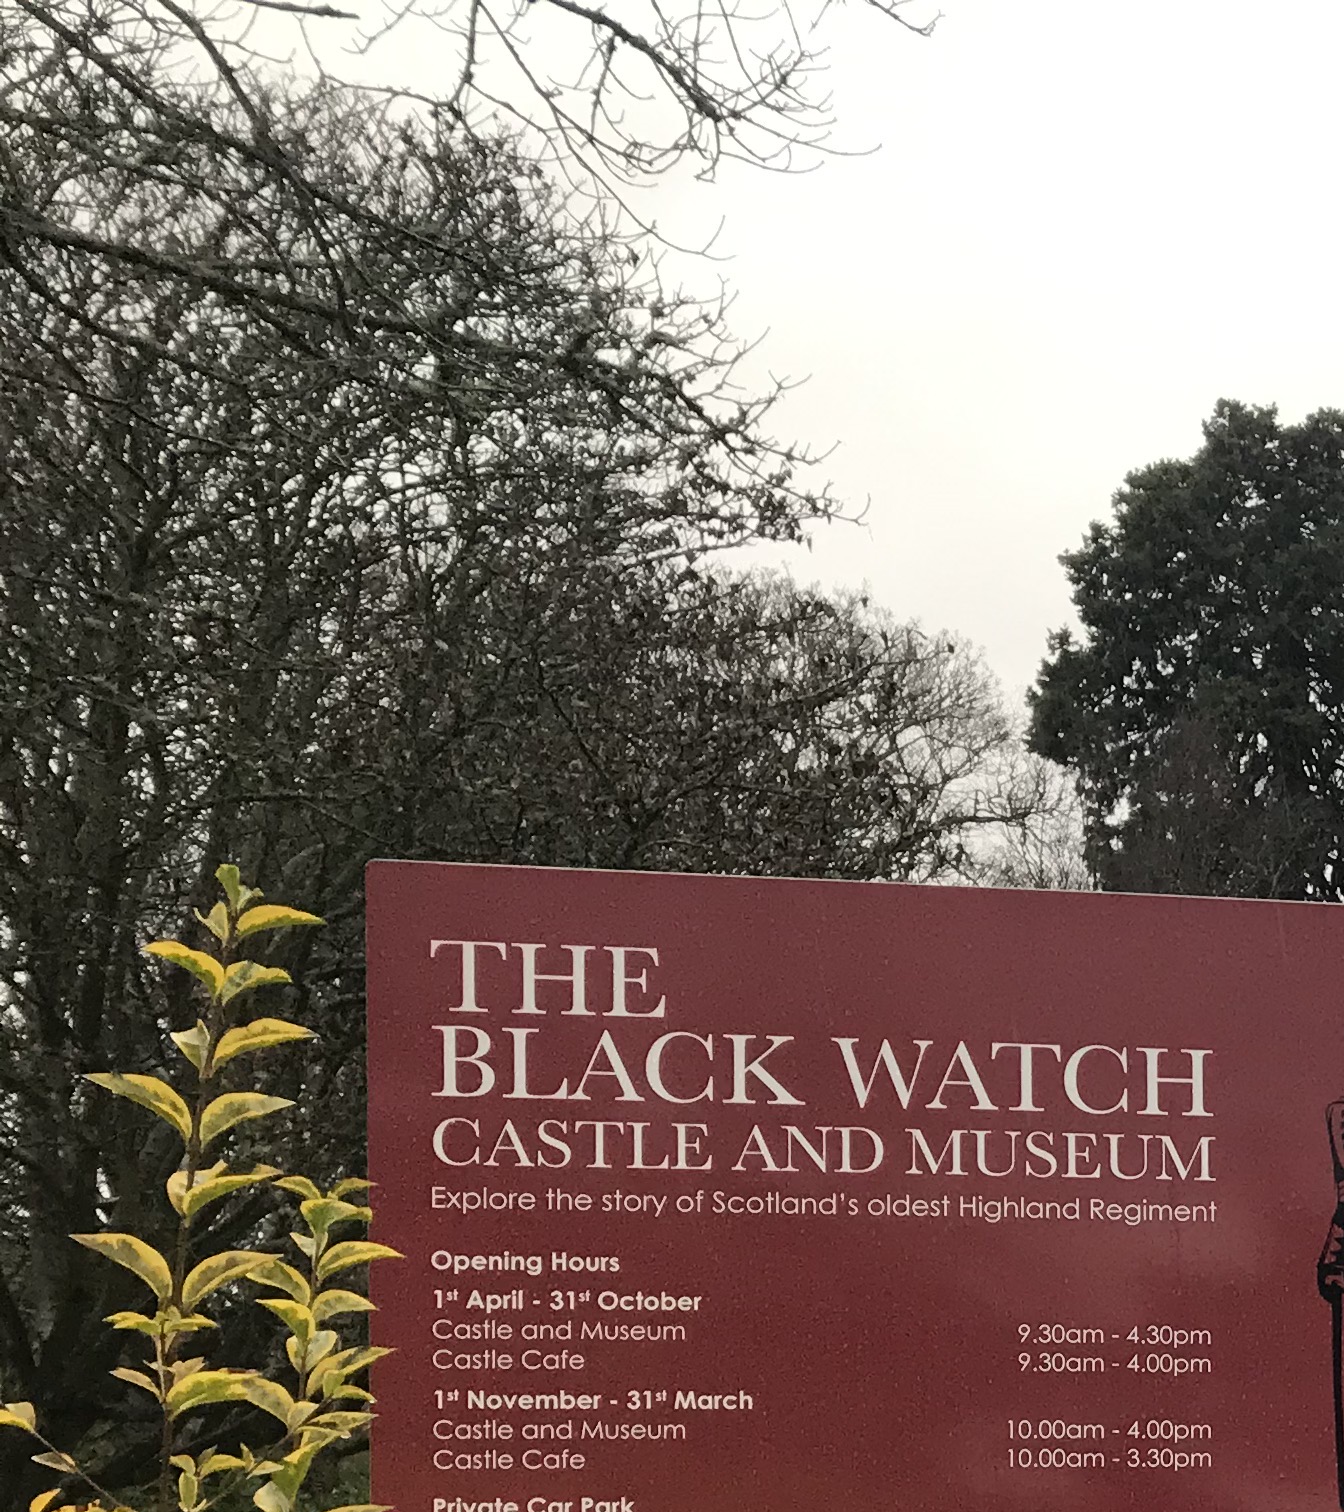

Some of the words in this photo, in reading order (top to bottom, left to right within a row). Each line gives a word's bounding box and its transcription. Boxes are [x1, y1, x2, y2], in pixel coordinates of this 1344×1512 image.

[430, 939, 666, 1018] THE
[430, 1025, 806, 1106] BLACK
[830, 1037, 1214, 1117] WATCH
[432, 1117, 713, 1170] CASTLE
[731, 1124, 885, 1174] AND
[904, 1127, 1217, 1182] MUSEUM
[431, 1186, 537, 1215] Explore
[545, 1187, 593, 1211] the
[601, 1189, 668, 1218] story
[676, 1189, 705, 1213] of
[712, 1190, 859, 1216] Scotland’s
[867, 1193, 951, 1217] oldest
[959, 1195, 1080, 1224] Highland
[1089, 1198, 1218, 1226] Regiment
[430, 1249, 543, 1276] Opening
[551, 1251, 620, 1272] Hours
[465, 1289, 524, 1314] April
[597, 1290, 703, 1311] October
[431, 1318, 513, 1340] Castle
[521, 1320, 572, 1341] and
[580, 1321, 686, 1341] Museum
[1017, 1323, 1105, 1344] 9.30am
[1126, 1325, 1212, 1349] 4.30pm
[432, 1348, 514, 1370] Castle
[521, 1349, 585, 1370] Cafe
[1018, 1352, 1105, 1373] 9.30am
[1126, 1353, 1212, 1377] 4.00pm
[467, 1389, 602, 1410] November
[674, 1390, 754, 1410] March
[432, 1419, 514, 1440] Castle
[521, 1419, 573, 1440] and
[580, 1420, 686, 1440] Museum
[1007, 1419, 1105, 1440] 10.00am
[1126, 1419, 1212, 1444] 4.00pm
[433, 1449, 514, 1470] Castle
[521, 1448, 586, 1470] Cafe
[1007, 1448, 1105, 1468] 10.00am
[1127, 1447, 1212, 1472] 3.30pm
